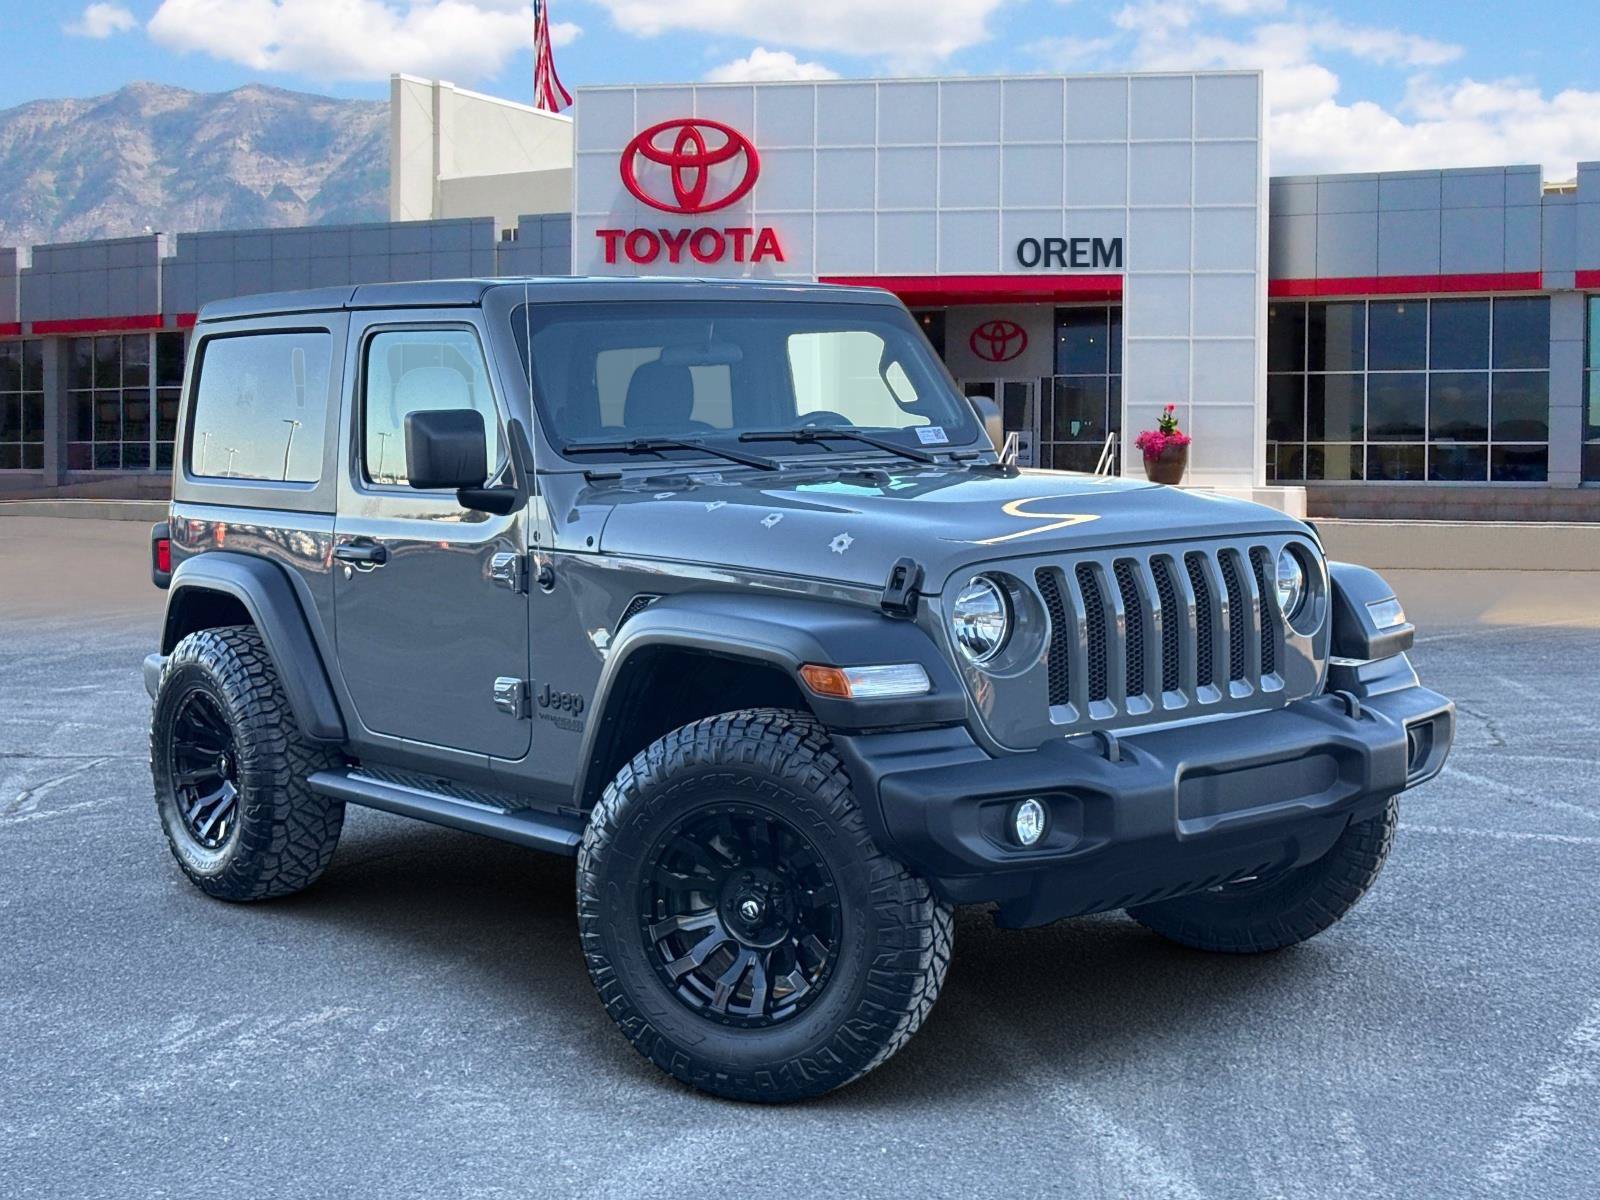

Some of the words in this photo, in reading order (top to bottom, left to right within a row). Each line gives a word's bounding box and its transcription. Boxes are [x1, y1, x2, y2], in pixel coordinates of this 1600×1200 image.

[596, 227, 784, 264] TOYOTA
[1017, 237, 1123, 268] OREM
[537, 683, 584, 718] Jeep
